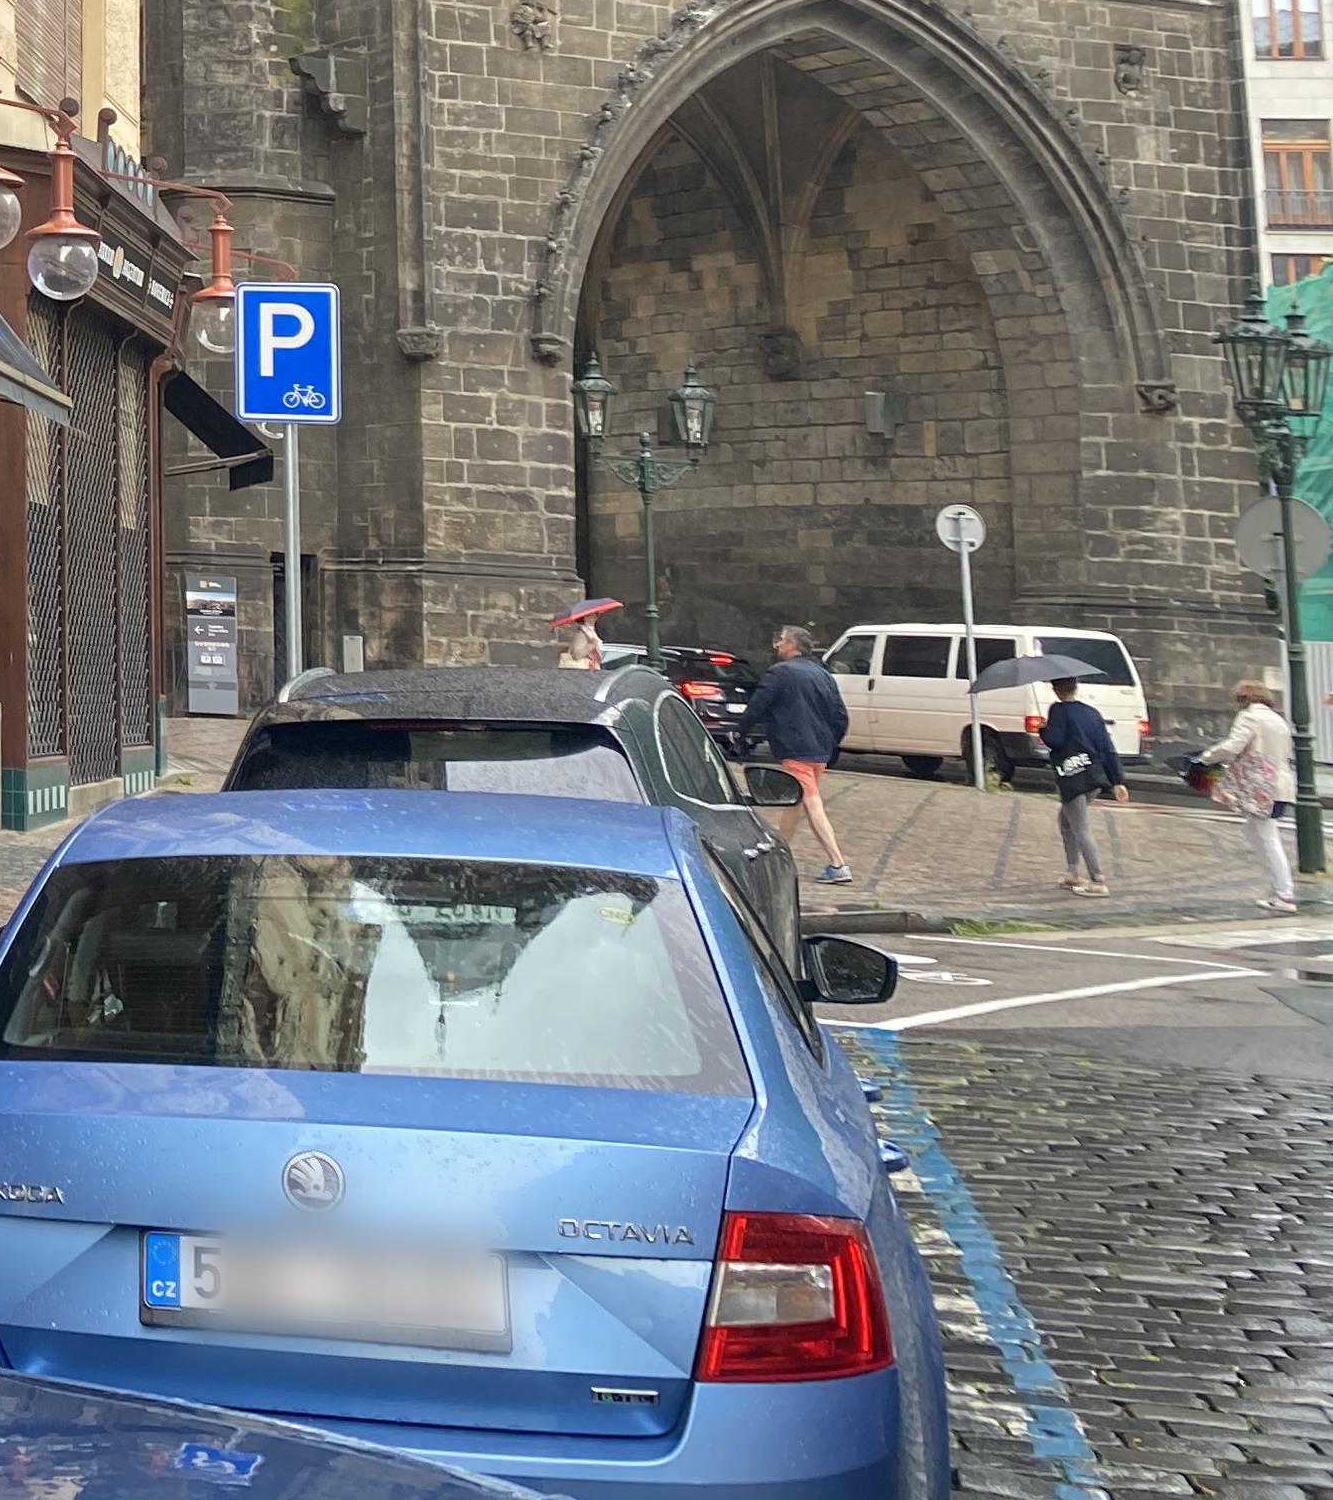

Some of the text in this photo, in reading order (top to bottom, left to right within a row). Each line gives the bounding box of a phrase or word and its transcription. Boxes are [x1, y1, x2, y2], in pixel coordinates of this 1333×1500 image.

[259, 302, 315, 377] P
[557, 1218, 695, 1246] OCTAVIA
[151, 1280, 177, 1298] CZ
